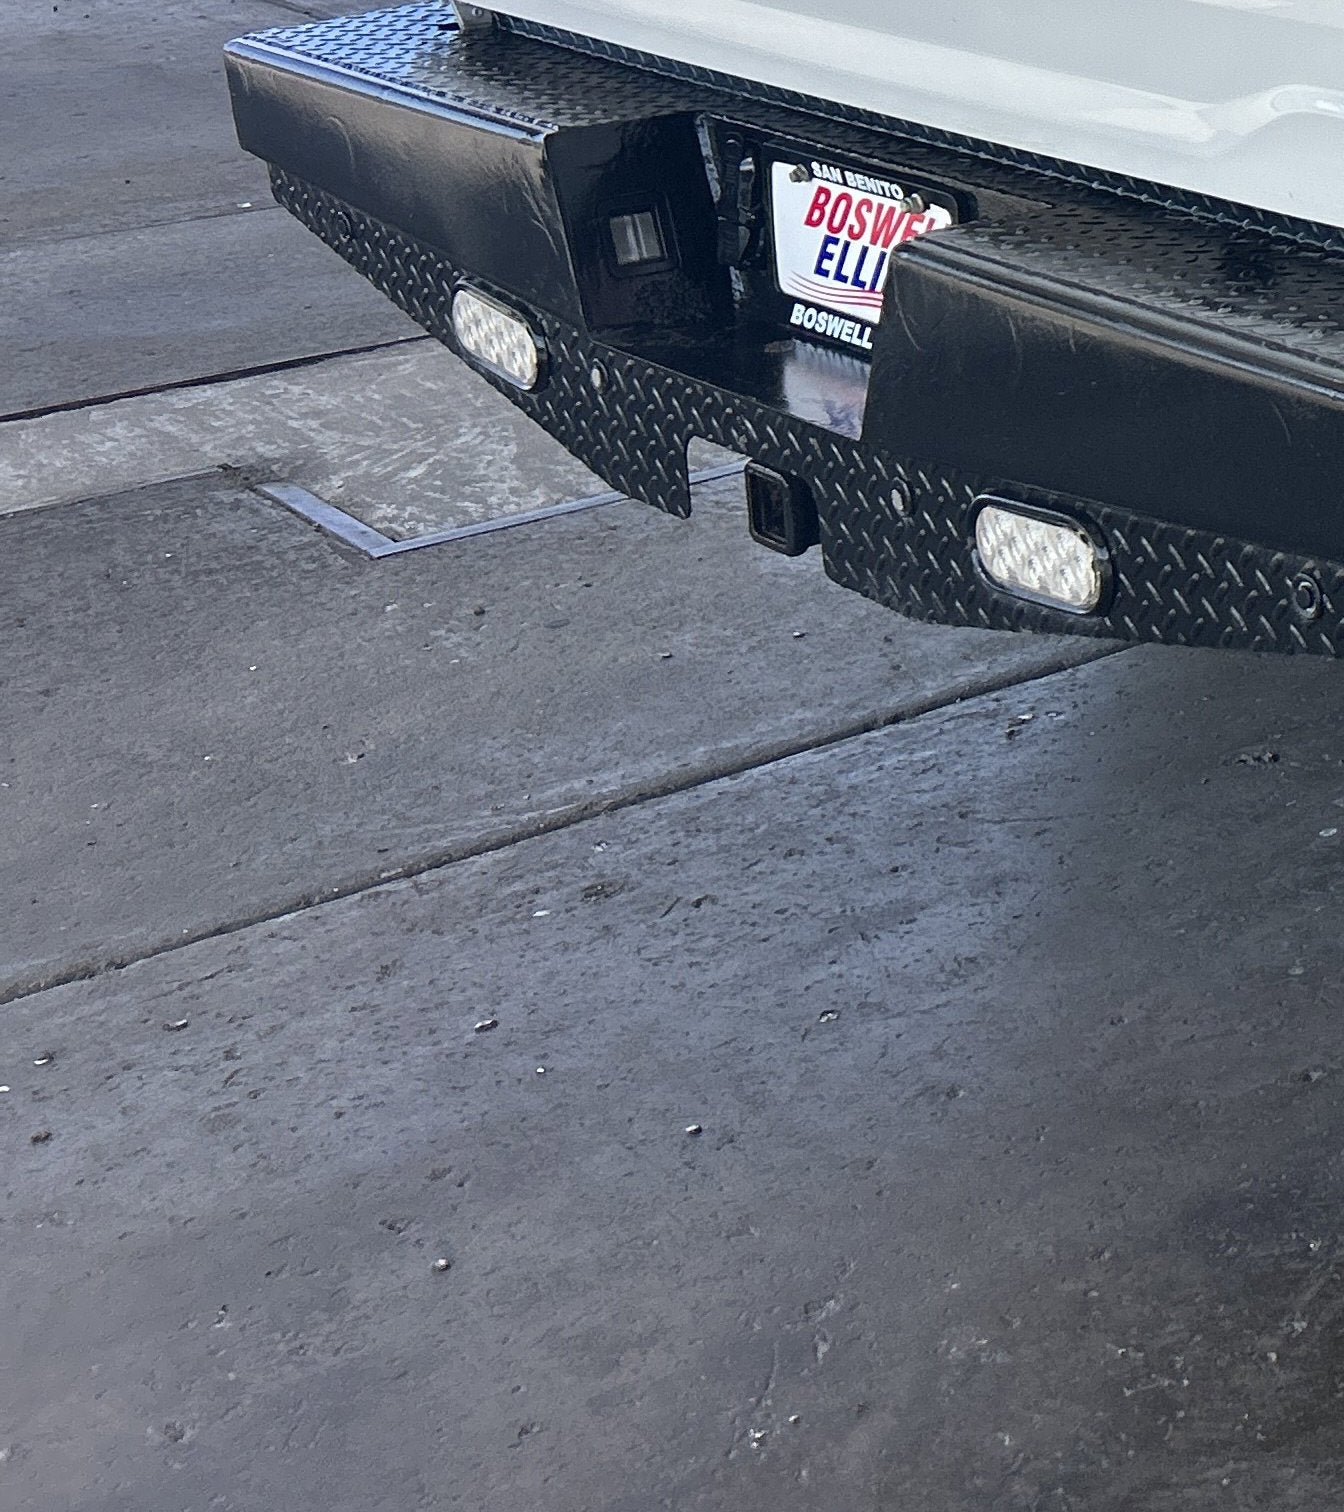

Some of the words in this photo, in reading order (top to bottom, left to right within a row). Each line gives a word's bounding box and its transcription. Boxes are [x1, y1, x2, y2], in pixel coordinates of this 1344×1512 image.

[810, 161, 843, 183] SAN
[843, 170, 905, 201] BENITO
[789, 302, 874, 350] BOSWELL
